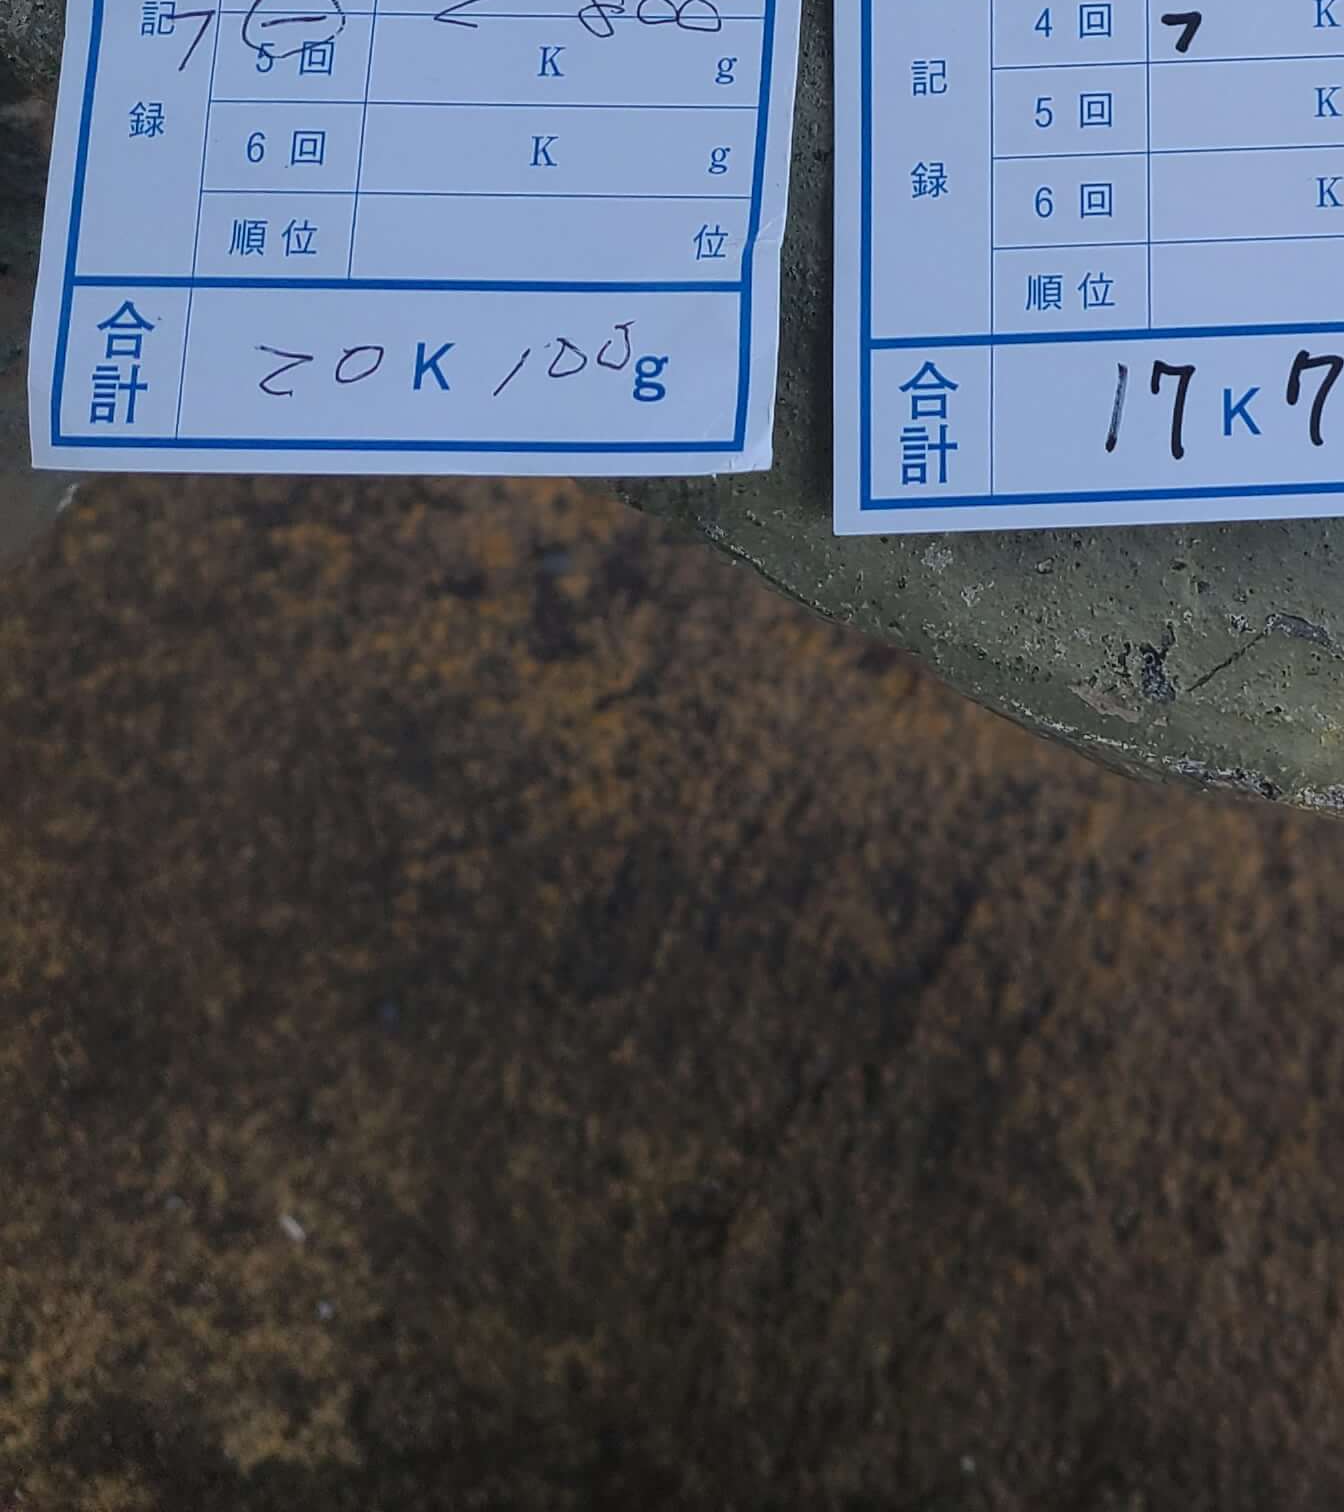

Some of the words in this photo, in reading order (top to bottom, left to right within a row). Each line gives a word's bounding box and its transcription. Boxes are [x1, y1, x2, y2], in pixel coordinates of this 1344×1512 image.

[1034, 3, 1112, 39] 4回
[253, 40, 337, 76] 5回
[1034, 92, 1113, 129] 5回
[246, 130, 326, 166] 6回
[1034, 182, 1113, 219] 6回
[228, 219, 318, 257] 順位
[693, 224, 729, 261] 位
[1025, 271, 1116, 311] 順位
[89, 300, 155, 424] 合計
[412, 342, 455, 391] K
[632, 355, 669, 403] g
[898, 360, 959, 486] 合計
[1106, 359, 1196, 462] 17
[1223, 387, 1262, 437] K
